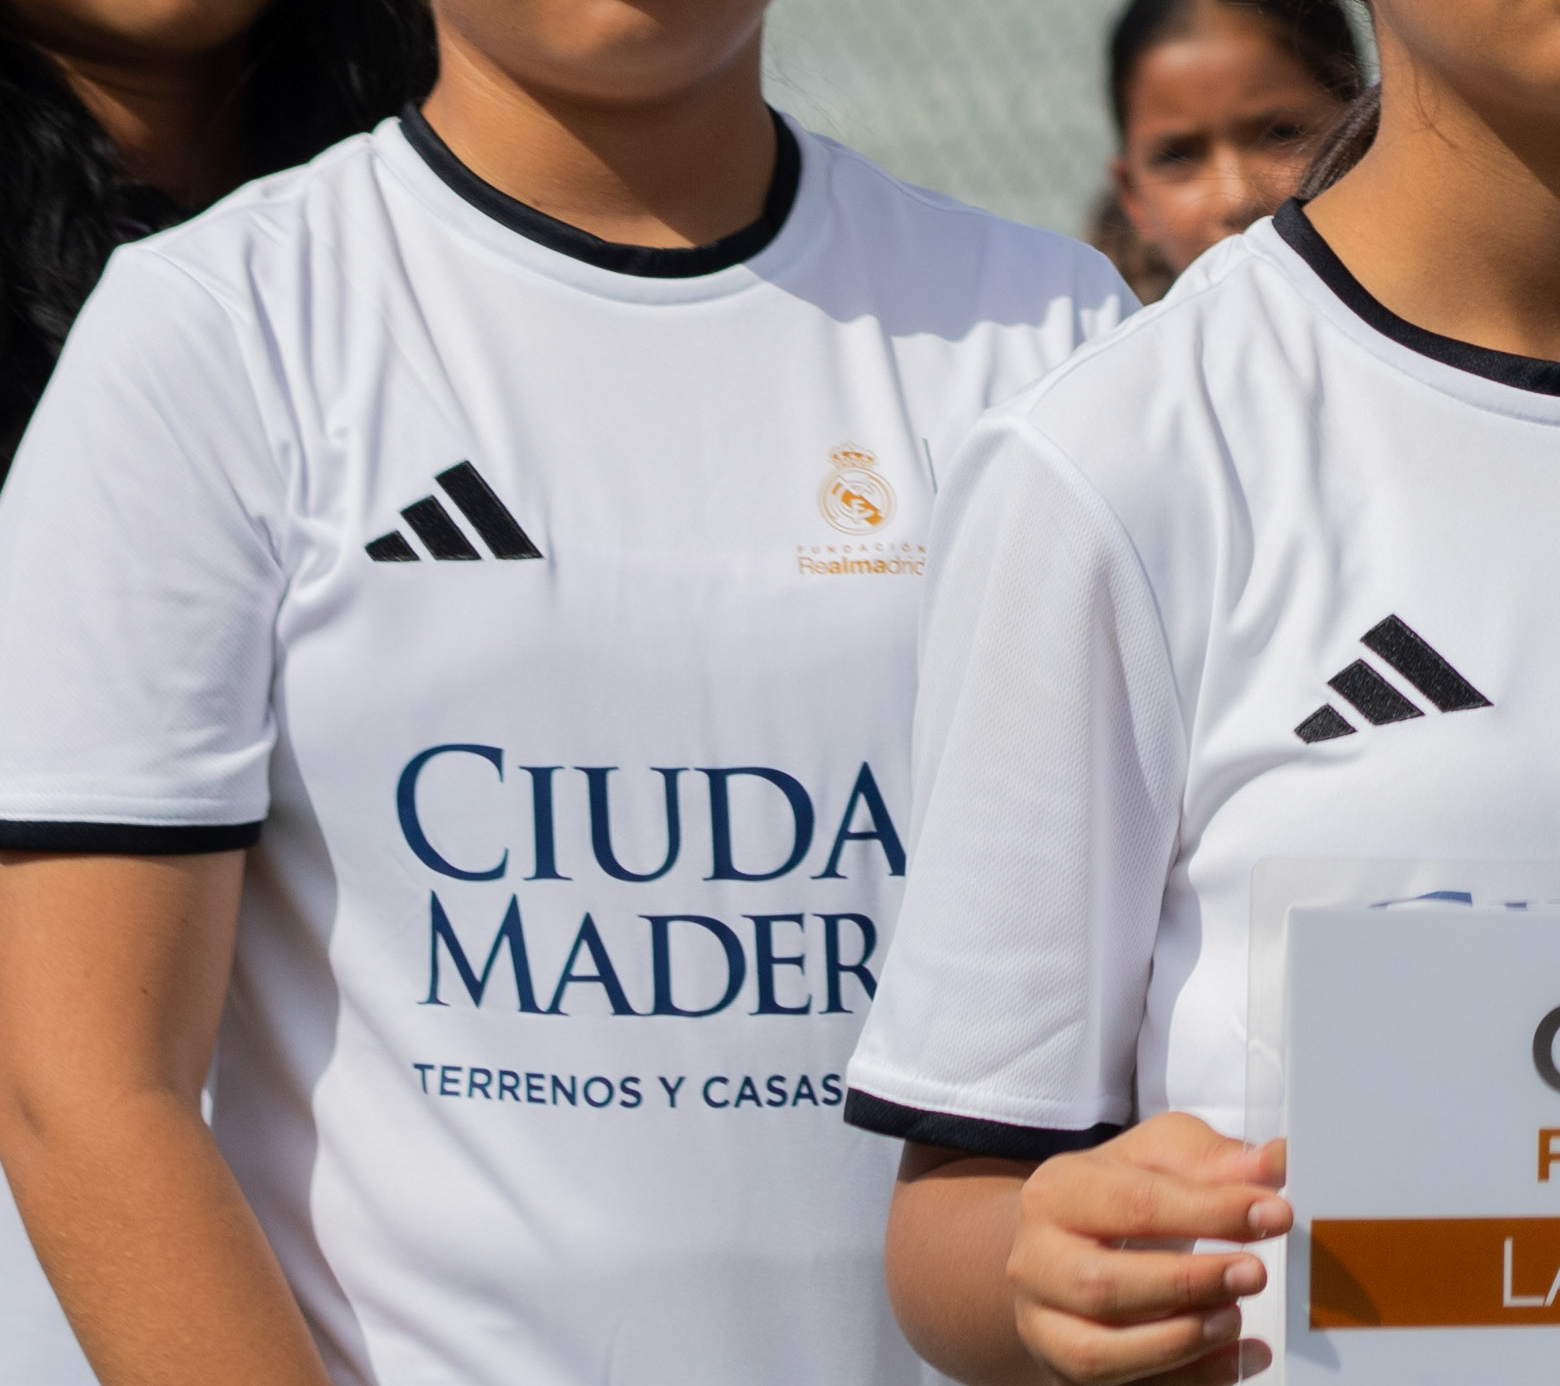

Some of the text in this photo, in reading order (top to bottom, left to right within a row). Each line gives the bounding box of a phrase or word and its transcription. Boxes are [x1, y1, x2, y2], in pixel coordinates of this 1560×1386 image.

[412, 1062, 843, 1108] TERRENOS Y CASAS
